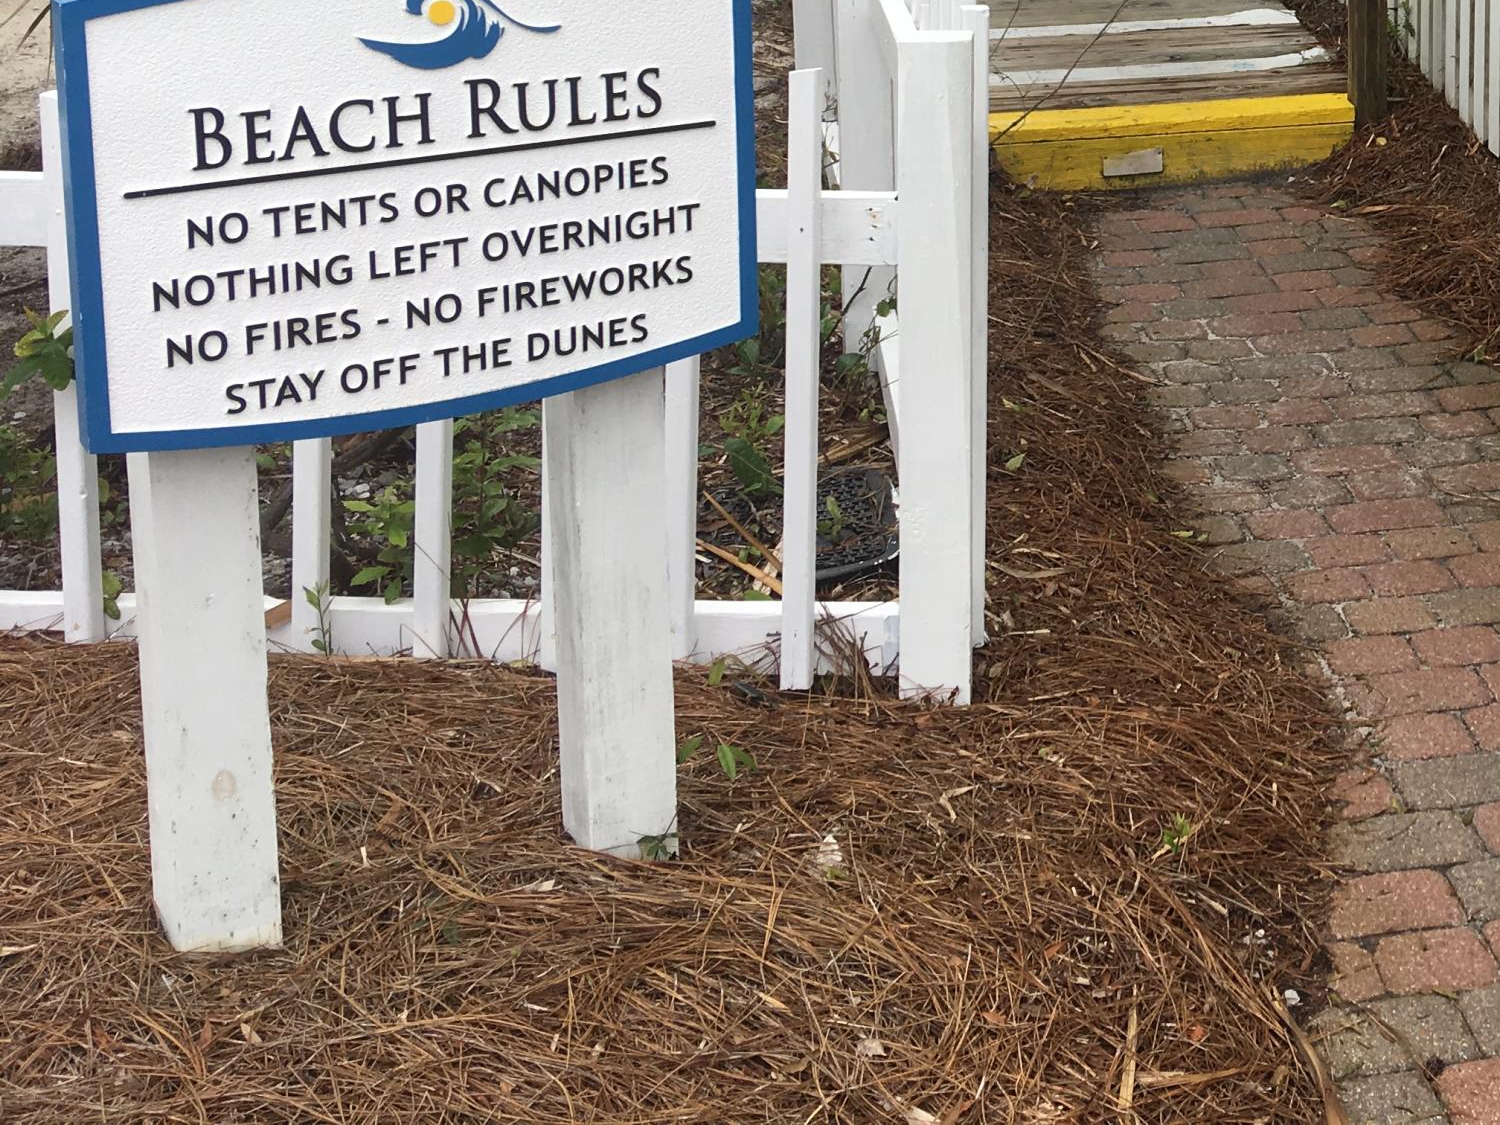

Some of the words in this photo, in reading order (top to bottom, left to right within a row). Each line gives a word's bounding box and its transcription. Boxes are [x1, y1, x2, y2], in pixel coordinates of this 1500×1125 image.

[187, 92, 436, 172] BEACH
[463, 67, 662, 139] RULES
[187, 212, 249, 250] NO
[262, 192, 399, 238] TENTS
[414, 183, 471, 218] OR
[483, 156, 669, 208] CANOPIES
[152, 254, 353, 313] NOTHING
[369, 236, 469, 280] LEFT
[482, 203, 701, 262] OVERNIGHT
[166, 330, 228, 368] NO
[245, 308, 361, 356] FIRES
[406, 293, 462, 329] NO
[478, 255, 693, 318] FIREWORKS
[225, 369, 325, 415] STAY
[340, 353, 421, 394] OFF
[433, 337, 513, 377] THE
[527, 313, 649, 363] DUNES
